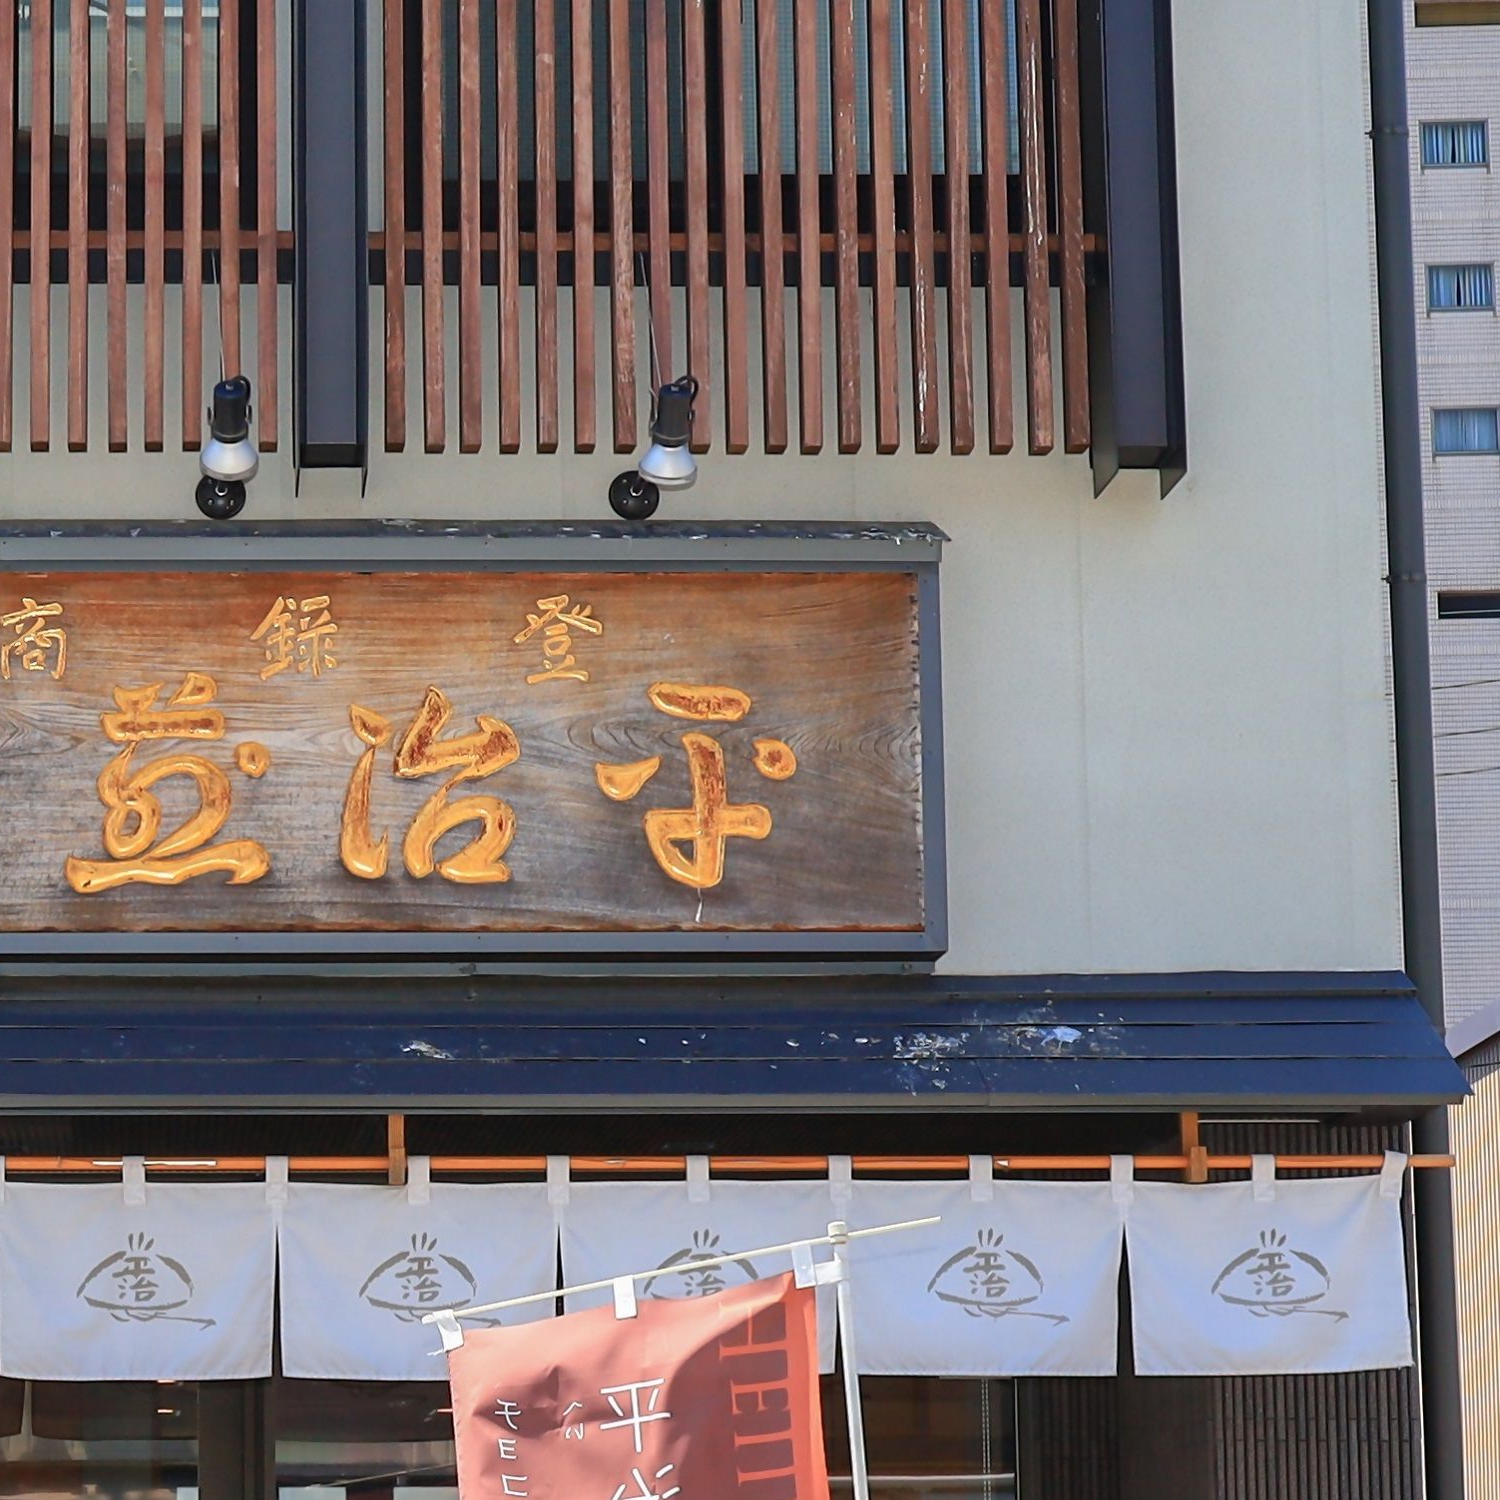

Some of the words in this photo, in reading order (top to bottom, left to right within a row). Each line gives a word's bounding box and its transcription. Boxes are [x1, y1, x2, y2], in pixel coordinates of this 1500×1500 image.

[115, 1255, 160, 1302] 平治
[397, 1255, 444, 1302] 平治
[962, 1251, 1012, 1298] 平治
[1245, 1251, 1296, 1298] 平治
